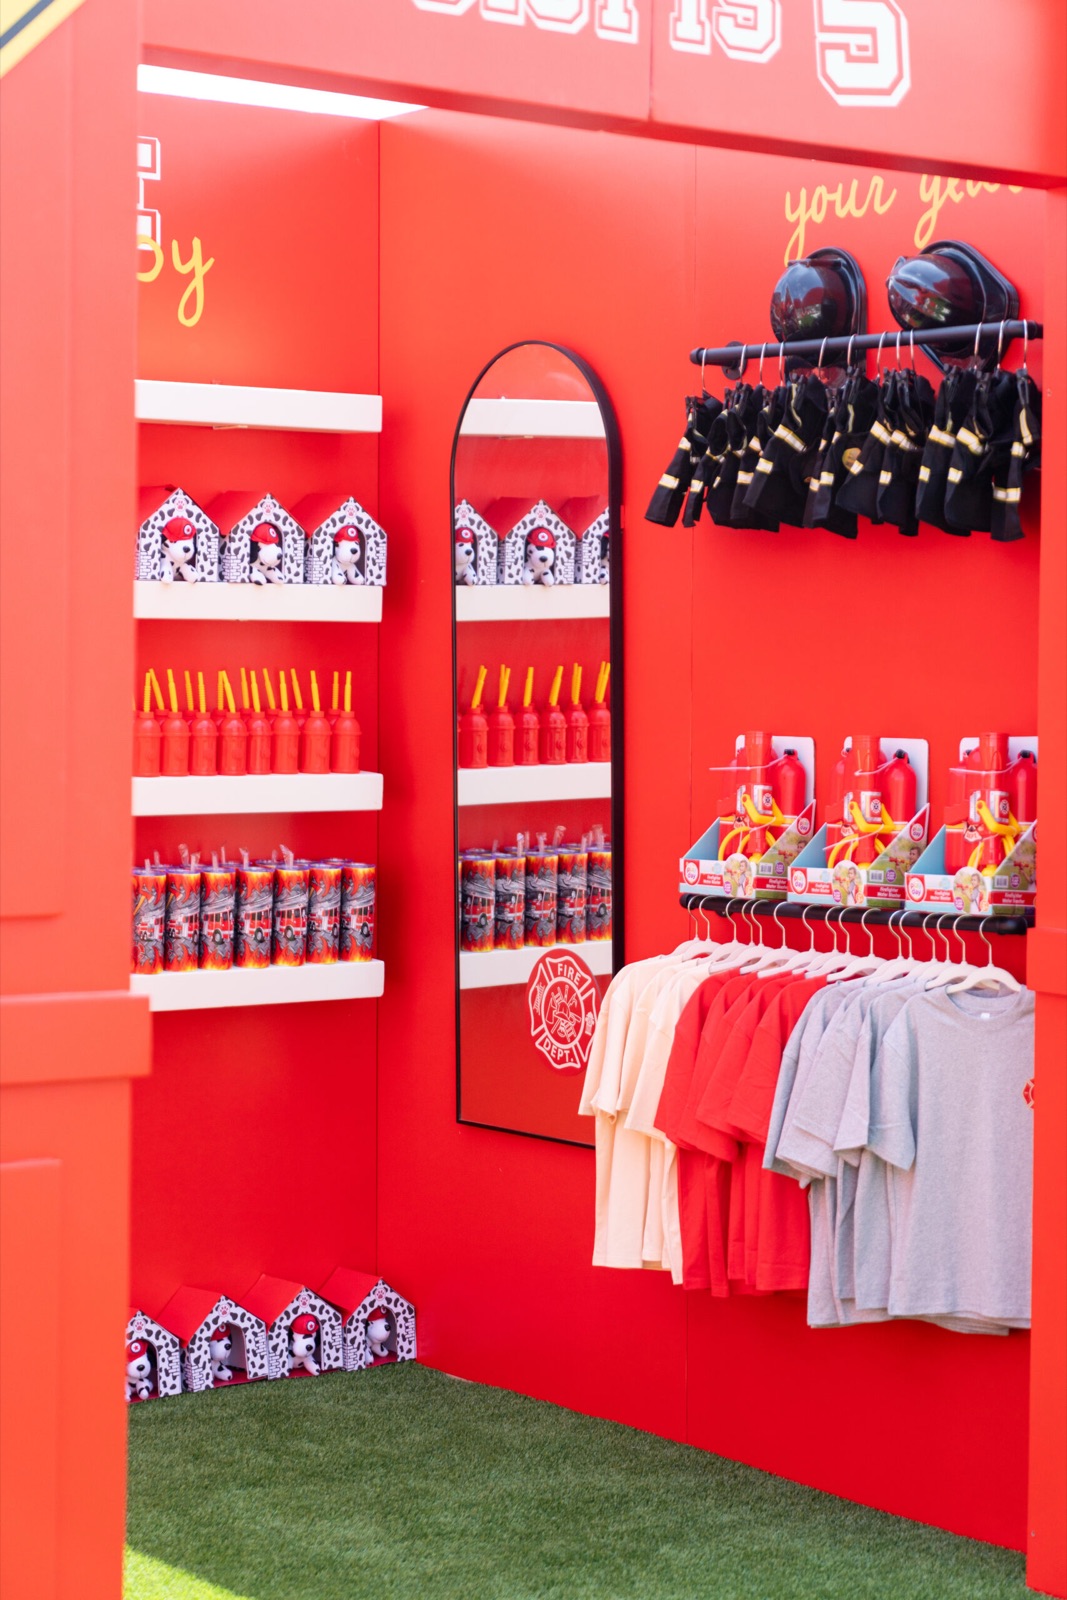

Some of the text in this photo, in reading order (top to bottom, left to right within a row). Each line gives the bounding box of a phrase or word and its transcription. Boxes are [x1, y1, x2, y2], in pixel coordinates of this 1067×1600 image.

[813, 0, 912, 107] 5
[784, 175, 897, 267] your
[557, 963, 582, 985] FIRE
[543, 1037, 574, 1063] DEPT.
